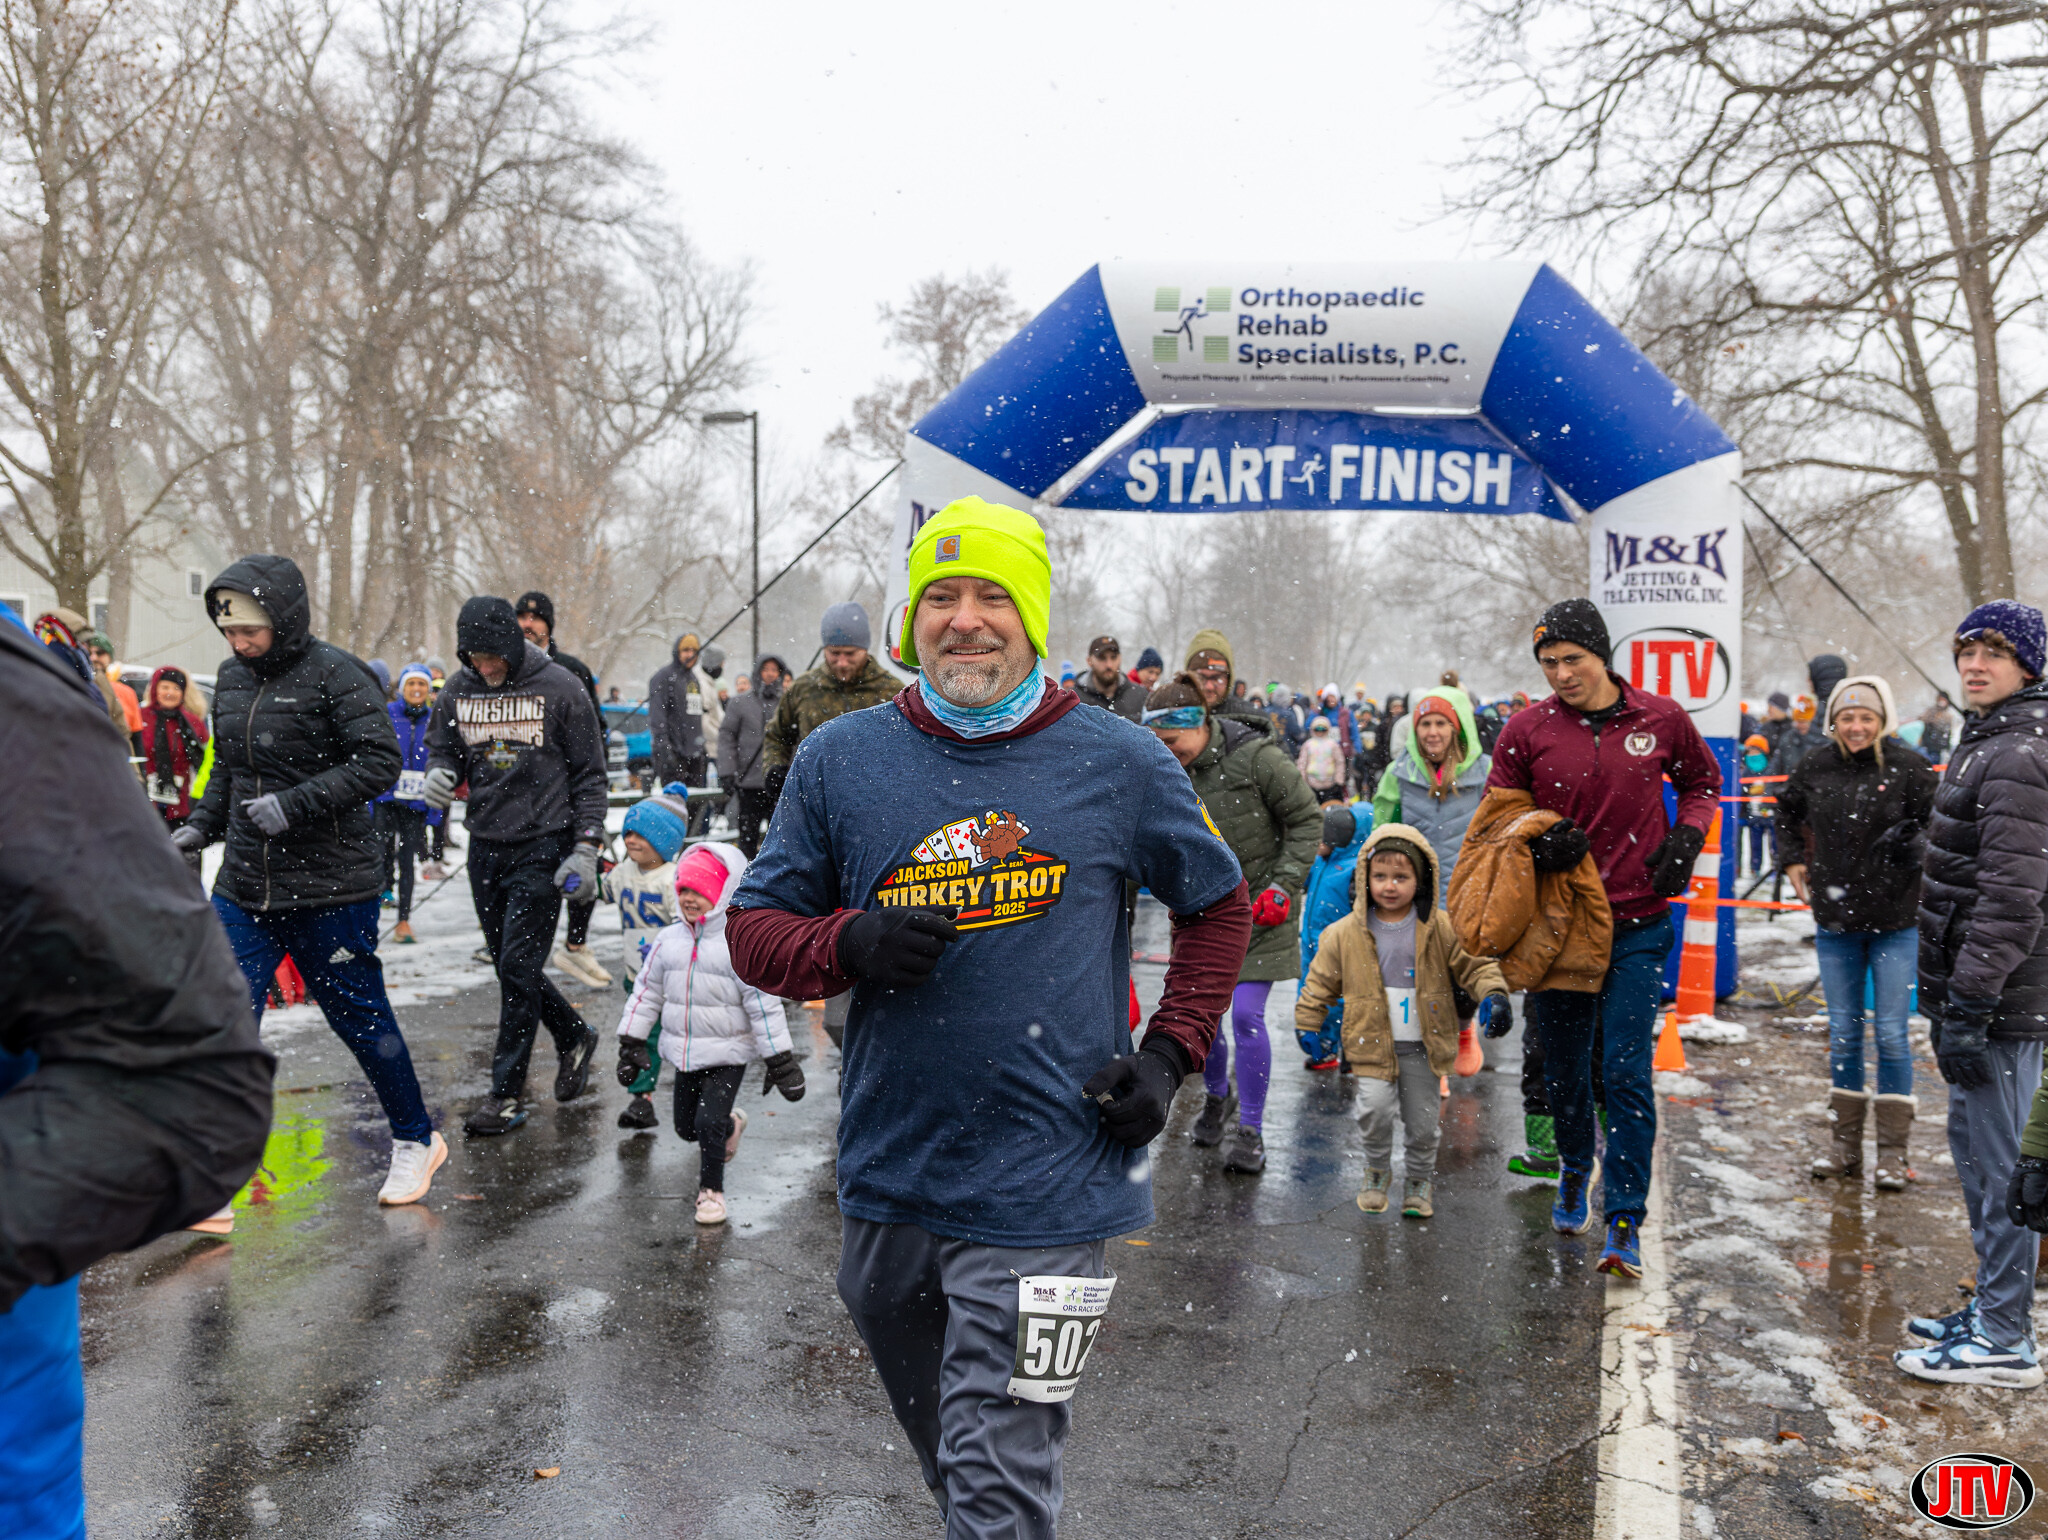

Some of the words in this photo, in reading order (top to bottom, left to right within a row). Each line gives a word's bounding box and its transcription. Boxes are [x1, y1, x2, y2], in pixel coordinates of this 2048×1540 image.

[1240, 286, 1424, 313] Orthopaedic
[1237, 313, 1328, 336] Rehab
[1237, 342, 1406, 369] Specialists,
[1414, 343, 1467, 365] P.C.
[1124, 445, 1296, 504] START
[1329, 444, 1513, 506] FINISH
[1604, 527, 1728, 583] M&K
[1623, 571, 1687, 587] JETTING
[1690, 572, 1702, 587] &
[456, 695, 545, 723] WRESTLING
[894, 859, 970, 884] JACKSON
[877, 875, 986, 909] TURKEY
[990, 864, 1067, 902] TROT
[620, 887, 664, 930] 65
[993, 900, 1026, 917] 2025
[1399, 996, 1410, 1025] 1
[1033, 1286, 1057, 1297] M&K
[1062, 1304, 1077, 1312] ORS
[1078, 1305, 1094, 1313] RACE
